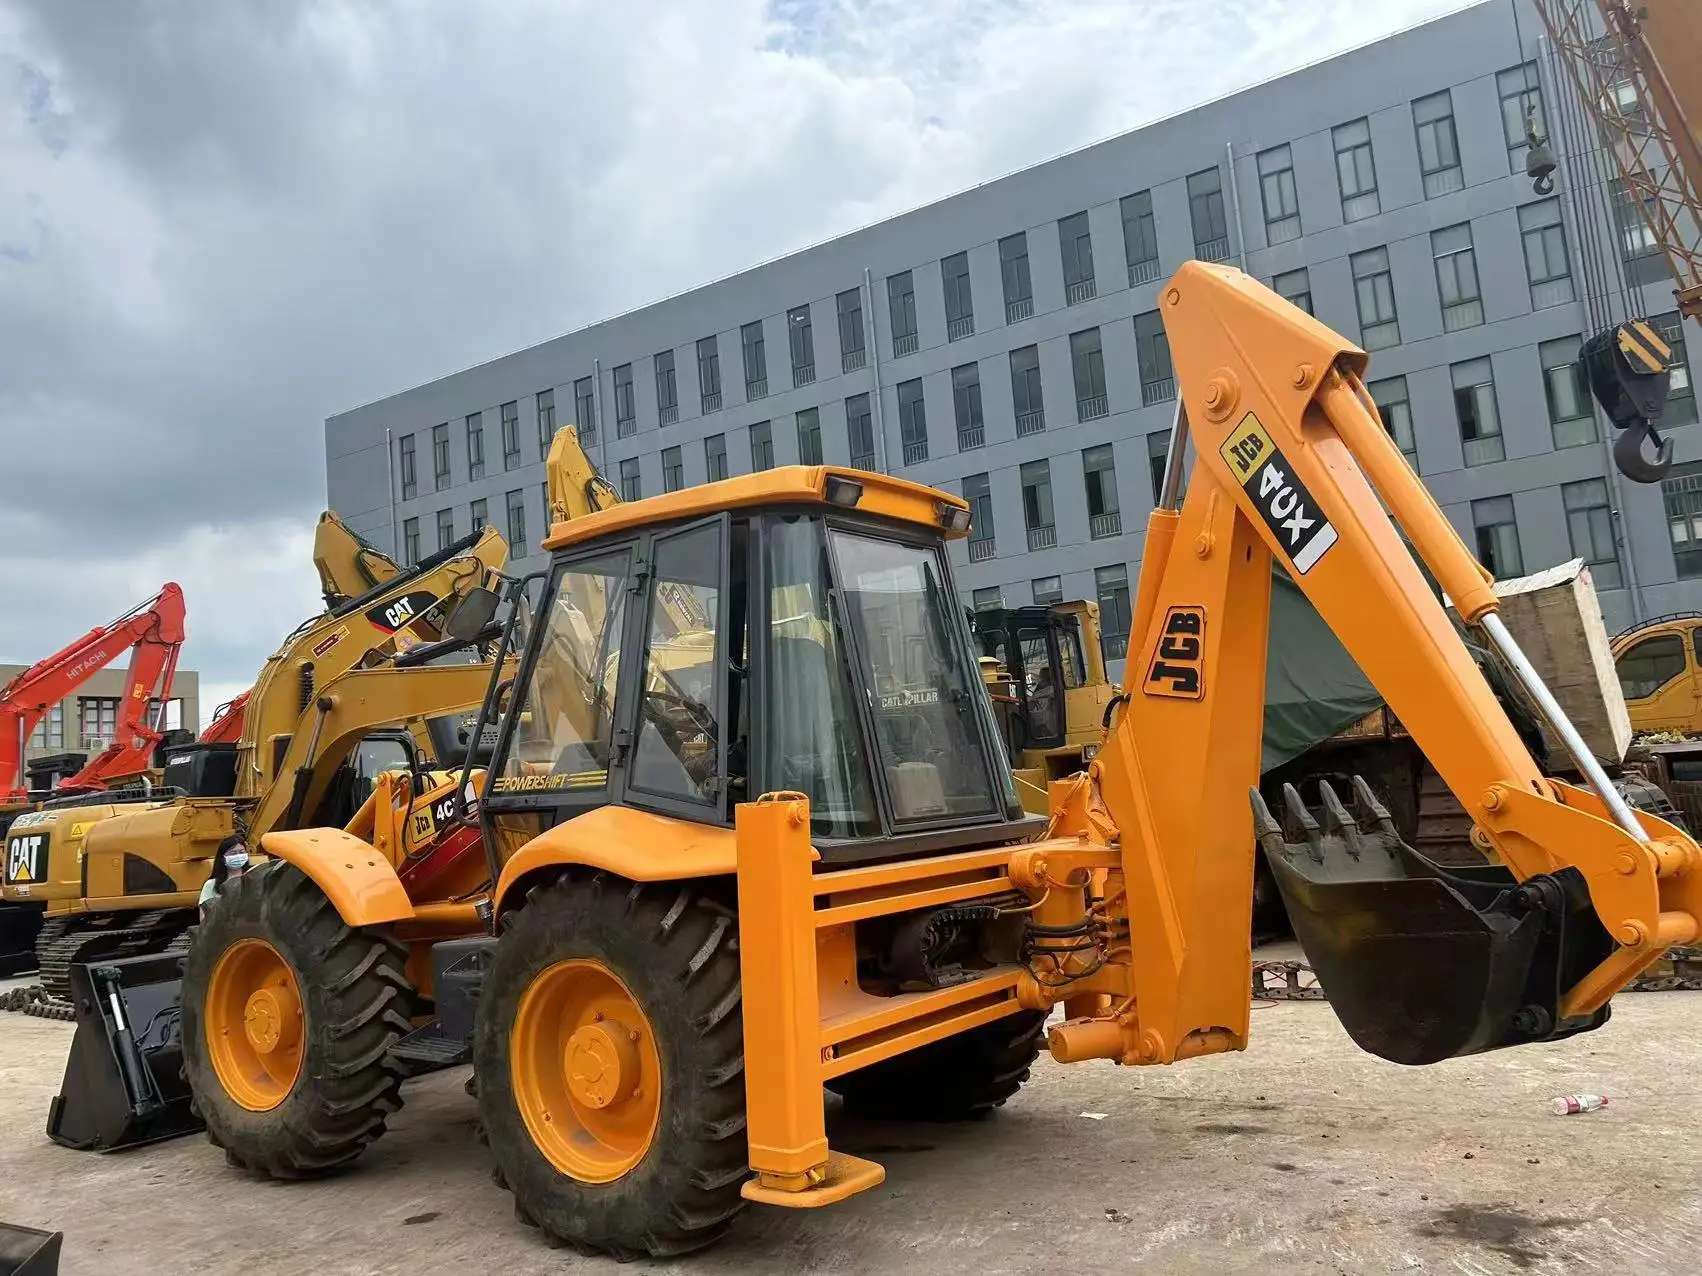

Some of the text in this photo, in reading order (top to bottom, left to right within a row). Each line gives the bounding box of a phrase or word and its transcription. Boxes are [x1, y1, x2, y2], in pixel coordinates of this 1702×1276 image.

[1230, 433, 1264, 474] JCB
[1259, 462, 1316, 546] 4CX
[385, 596, 415, 627] CAT
[66, 650, 107, 680] HITACHI
[1150, 612, 1200, 692] JCB
[503, 774, 567, 791] POWERSHIFT
[415, 814, 431, 836] JCB
[436, 798, 456, 821] 4C
[9, 835, 42, 881] CAT
